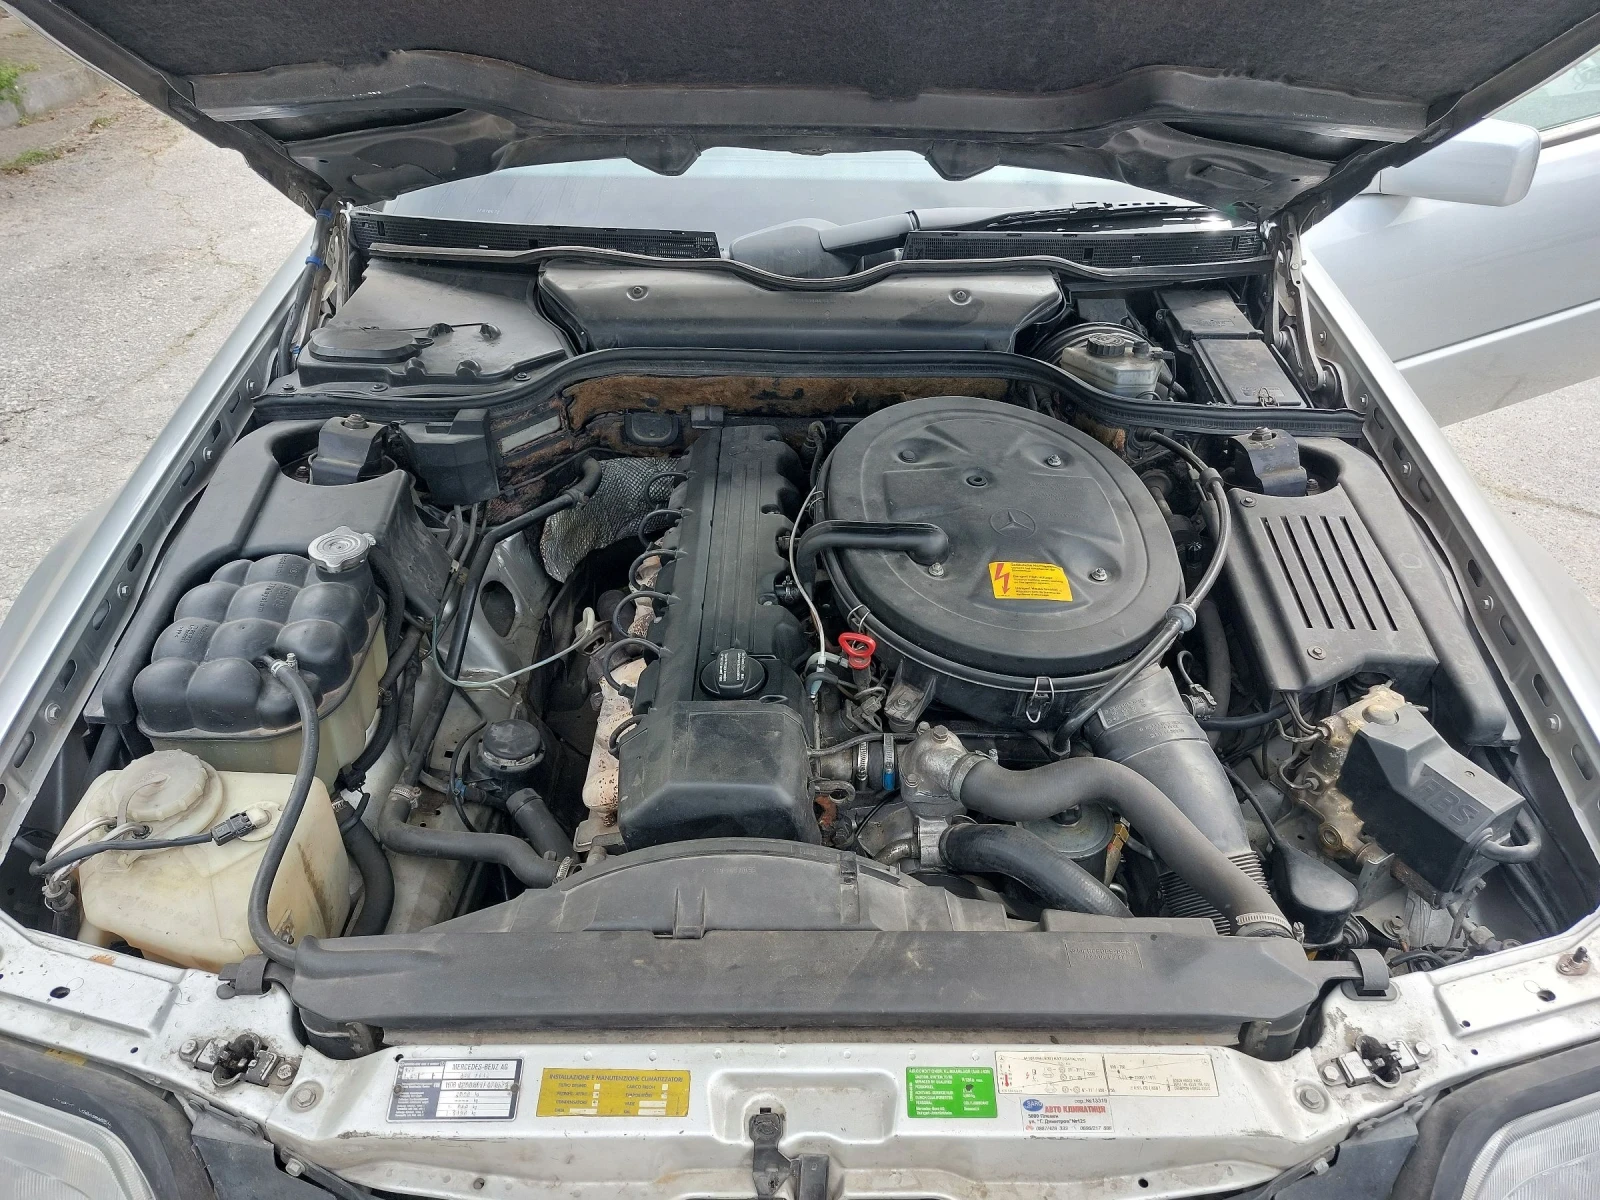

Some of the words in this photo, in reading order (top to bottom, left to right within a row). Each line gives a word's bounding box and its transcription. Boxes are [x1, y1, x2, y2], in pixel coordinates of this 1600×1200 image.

[1412, 778, 1480, 826] ABS
[452, 1063, 499, 1071] MERCEDES-BENZ
[500, 1063, 509, 1071] AG
[549, 1073, 591, 1081] INSTALLAZIONE
[1044, 1106, 1062, 1114] АВТО
